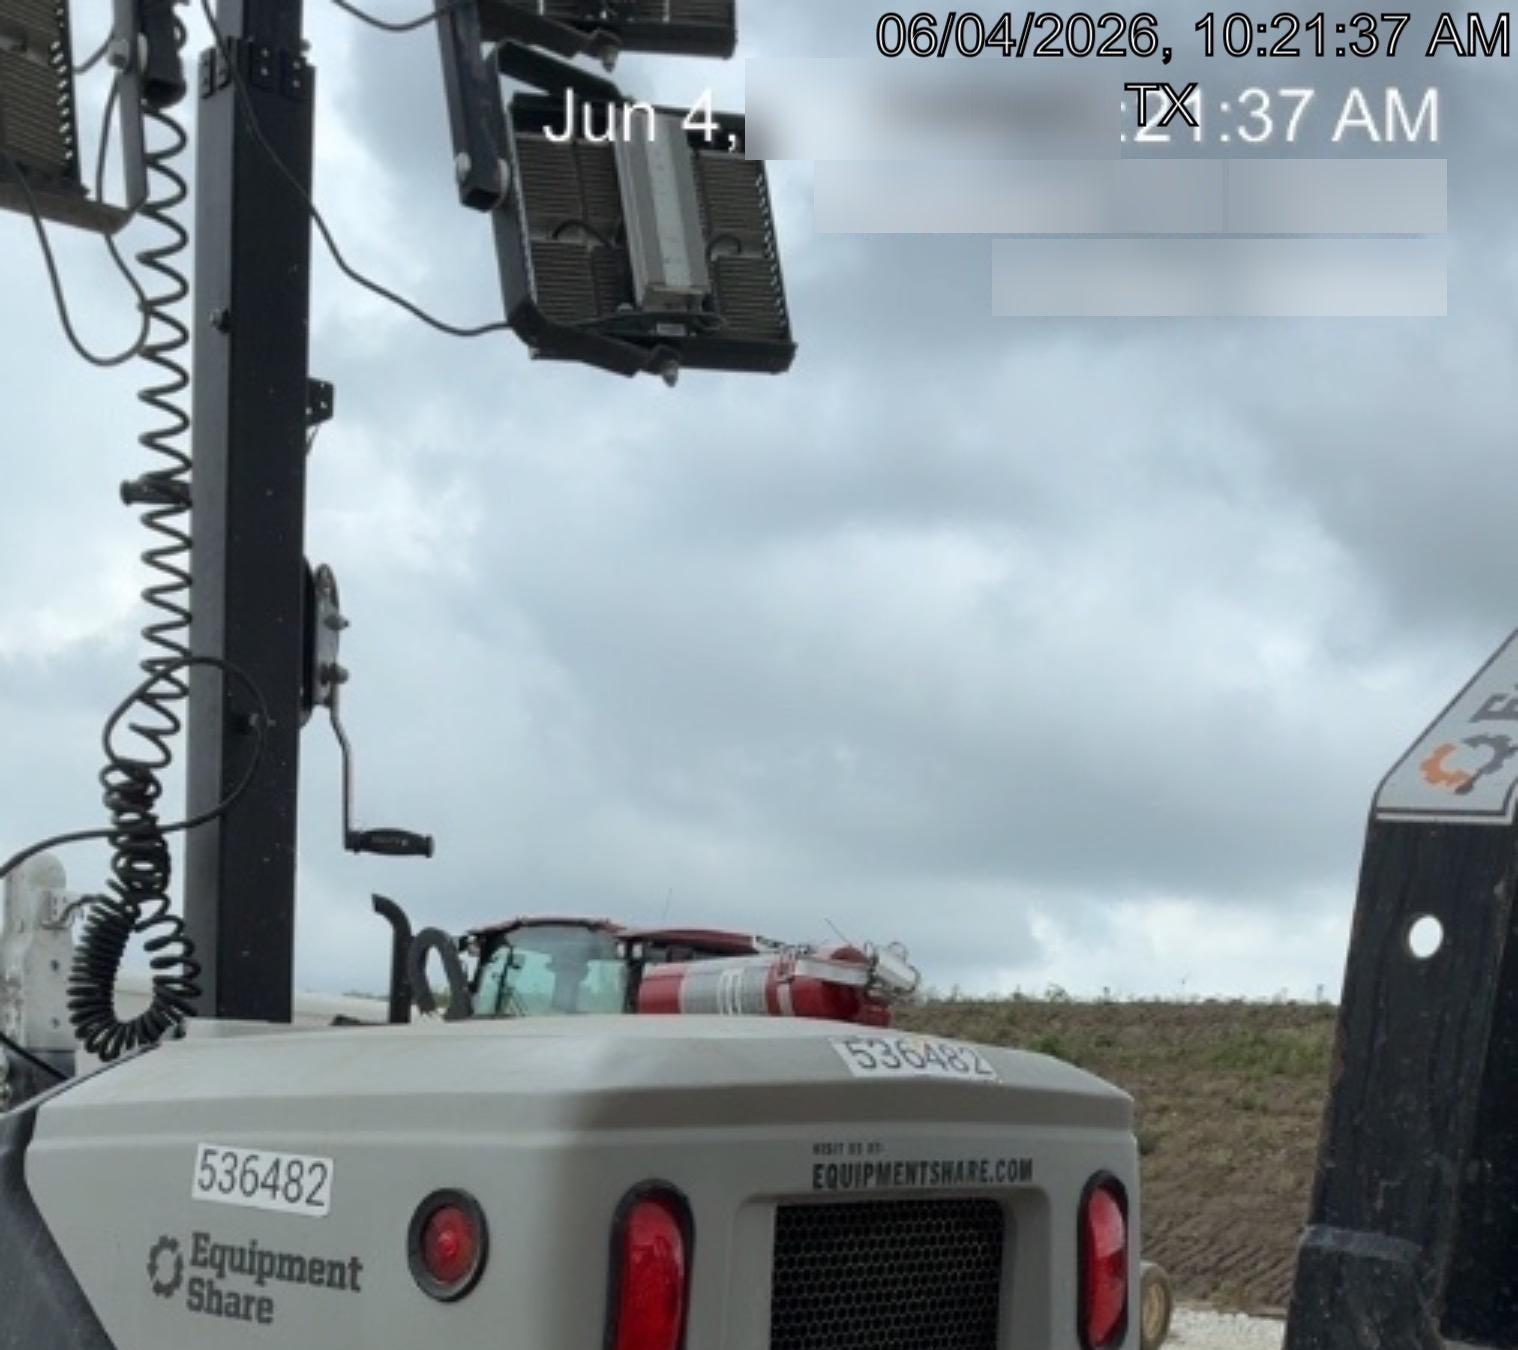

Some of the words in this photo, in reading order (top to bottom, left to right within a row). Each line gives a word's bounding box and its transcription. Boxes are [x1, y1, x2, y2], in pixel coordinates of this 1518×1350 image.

[842, 1035, 994, 1075] 536482
[198, 1148, 329, 1208] 536482
[812, 1158, 1034, 1189] EQUIPMENTSHARE.COM
[189, 1231, 364, 1292] Equipment
[186, 1277, 274, 1326] Share
